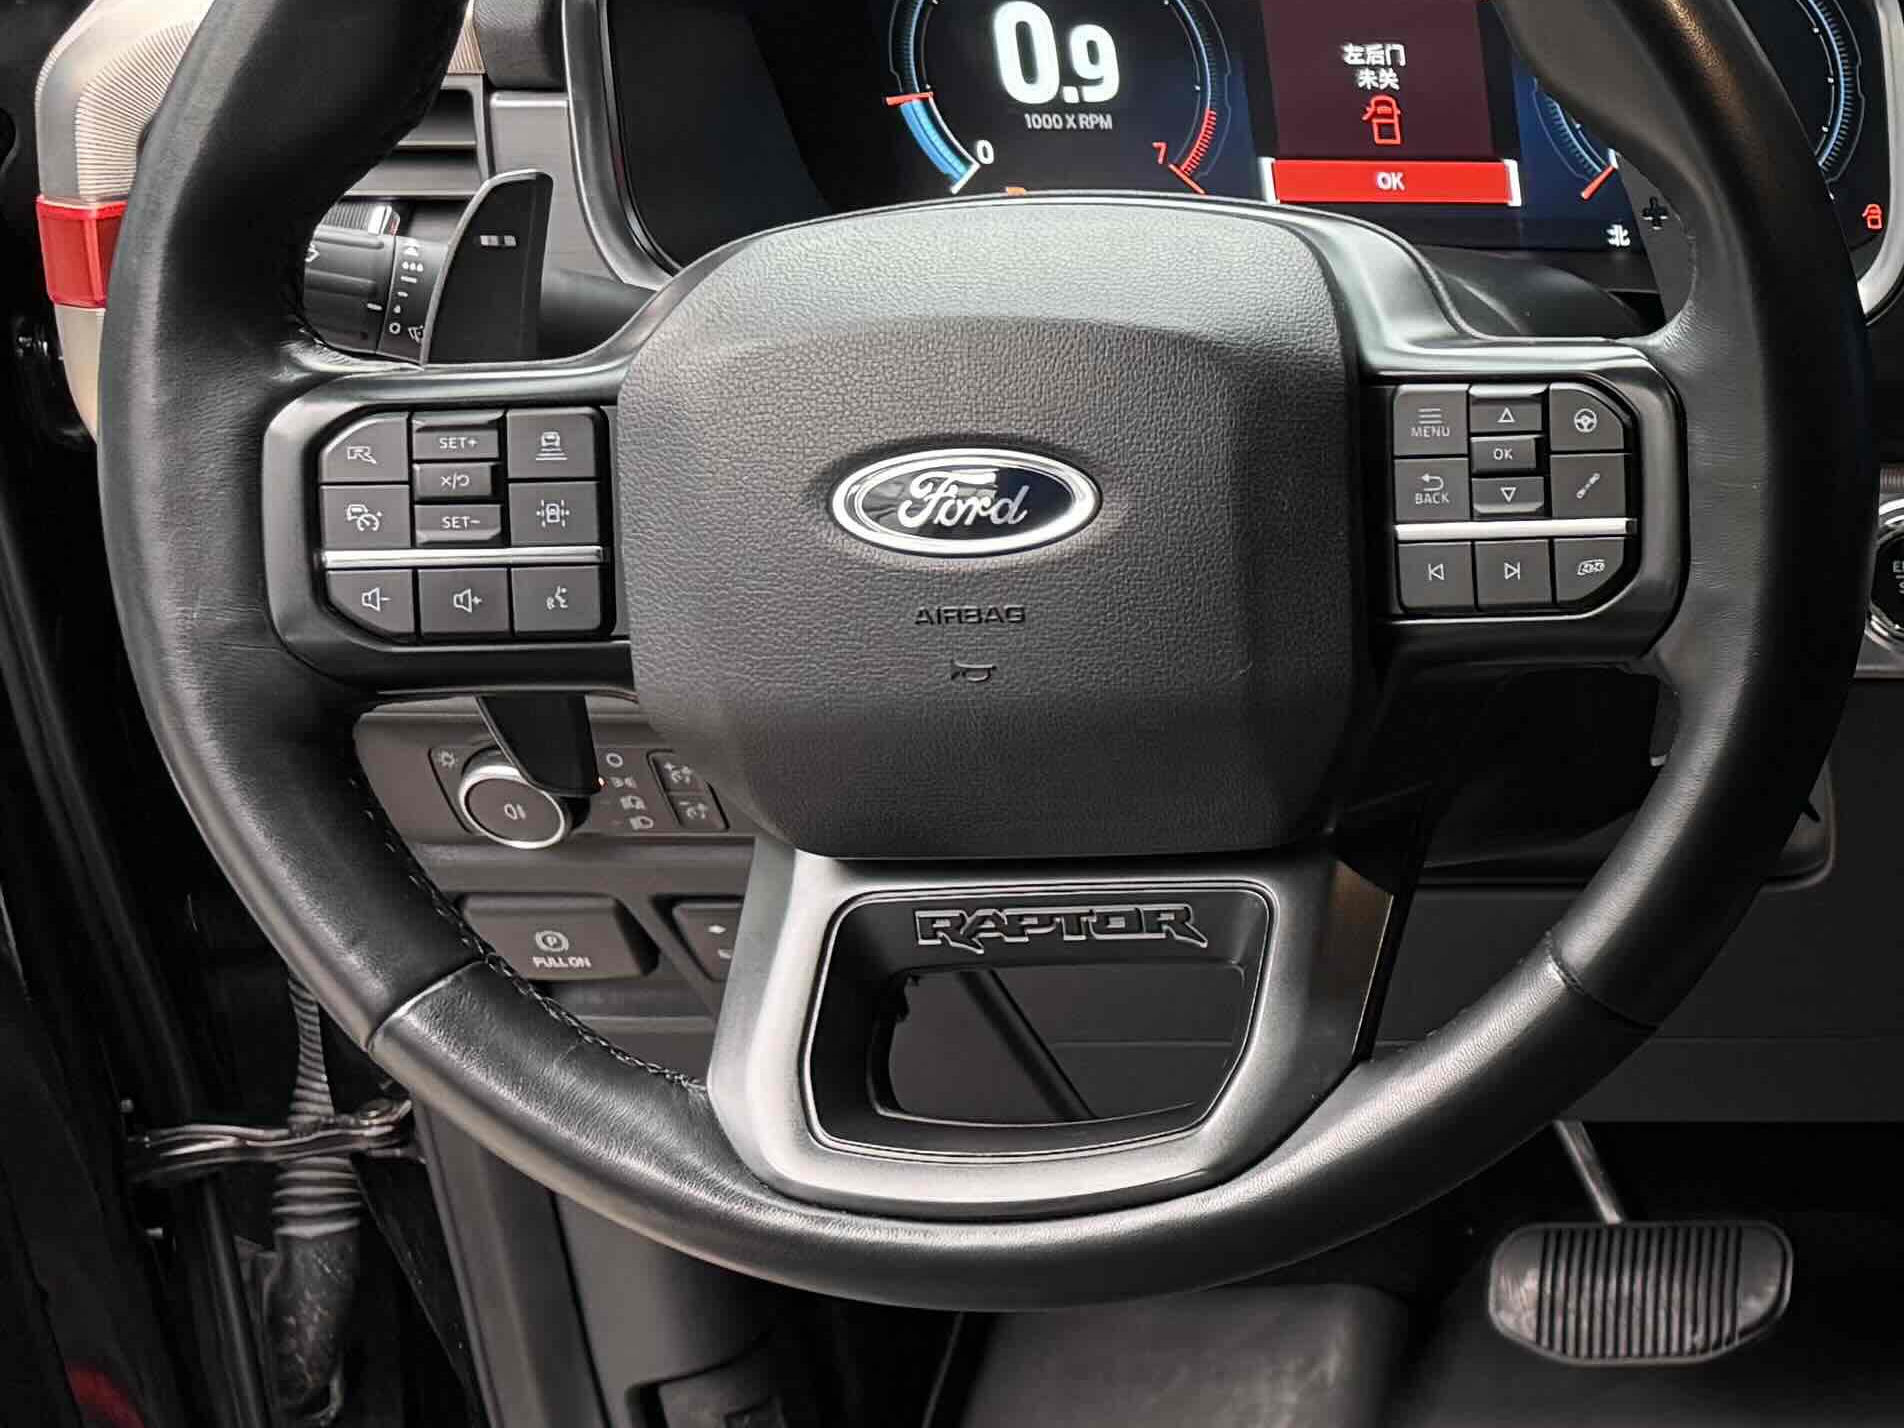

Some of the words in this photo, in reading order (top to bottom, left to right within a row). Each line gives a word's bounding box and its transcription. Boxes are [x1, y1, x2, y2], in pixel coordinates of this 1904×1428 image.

[993, 0, 1120, 104] 0.9
[1341, 43, 1406, 67] 左后门
[1357, 68, 1400, 91] 未关
[1024, 113, 1063, 130] 1000
[1065, 113, 1077, 130] X
[1079, 113, 1113, 130] RPM
[975, 139, 995, 165] 0
[1152, 141, 1168, 165] 7
[1375, 172, 1406, 191] OK
[1606, 223, 1631, 247] 北
[1411, 426, 1450, 438] MENU
[439, 437, 478, 449] SET+
[1493, 448, 1513, 461] OK
[897, 467, 1031, 529] Ford
[1415, 492, 1450, 505] BACK
[914, 605, 1027, 625] AIRBAG
[915, 903, 1208, 955] RAPTOR
[532, 956, 567, 969] PULL
[567, 956, 592, 969] ON
